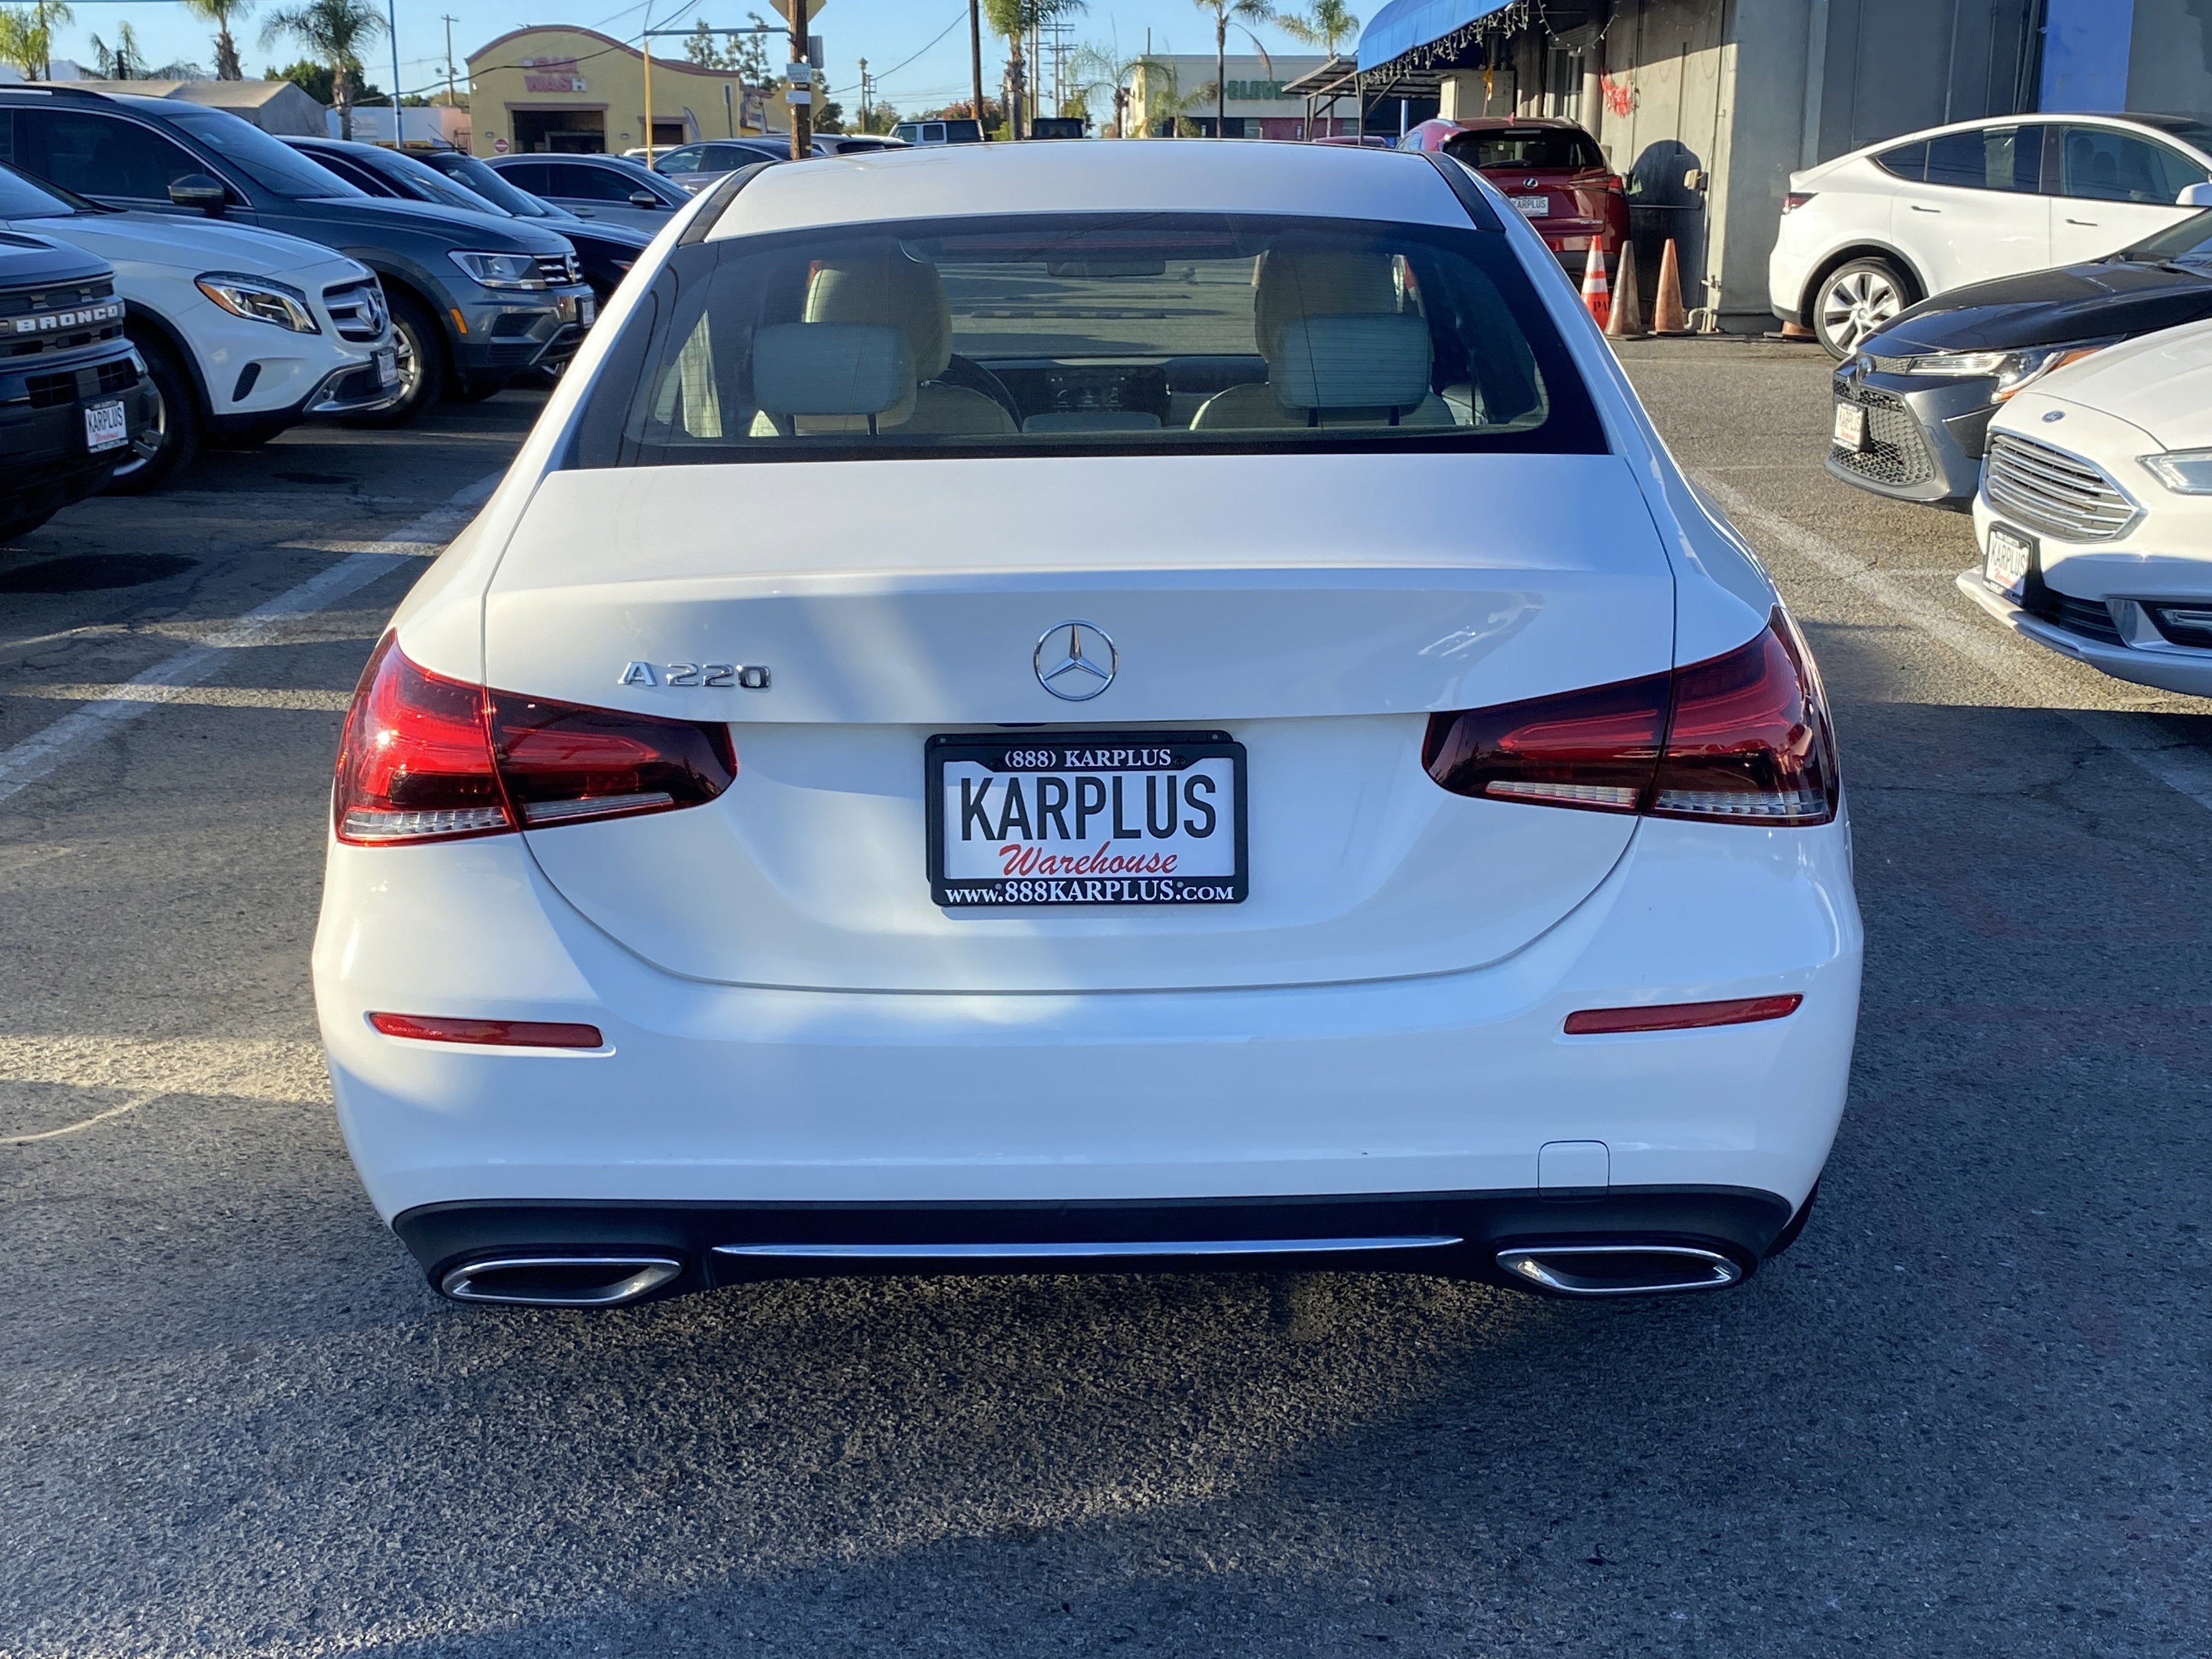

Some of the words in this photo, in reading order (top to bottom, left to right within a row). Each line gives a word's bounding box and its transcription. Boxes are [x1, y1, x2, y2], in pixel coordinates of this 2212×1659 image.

[524, 75, 586, 92] WASH
[16, 304, 119, 333] BRONCO
[87, 407, 123, 434] KARPLUS
[1991, 540, 2026, 577] KARPLUS
[618, 661, 657, 686] A
[665, 663, 771, 689] 220
[1005, 750, 1057, 768] (888)
[1064, 749, 1172, 767] KARPLUS
[961, 775, 1217, 841] KARPLUS
[998, 840, 1178, 876] Warehouse
